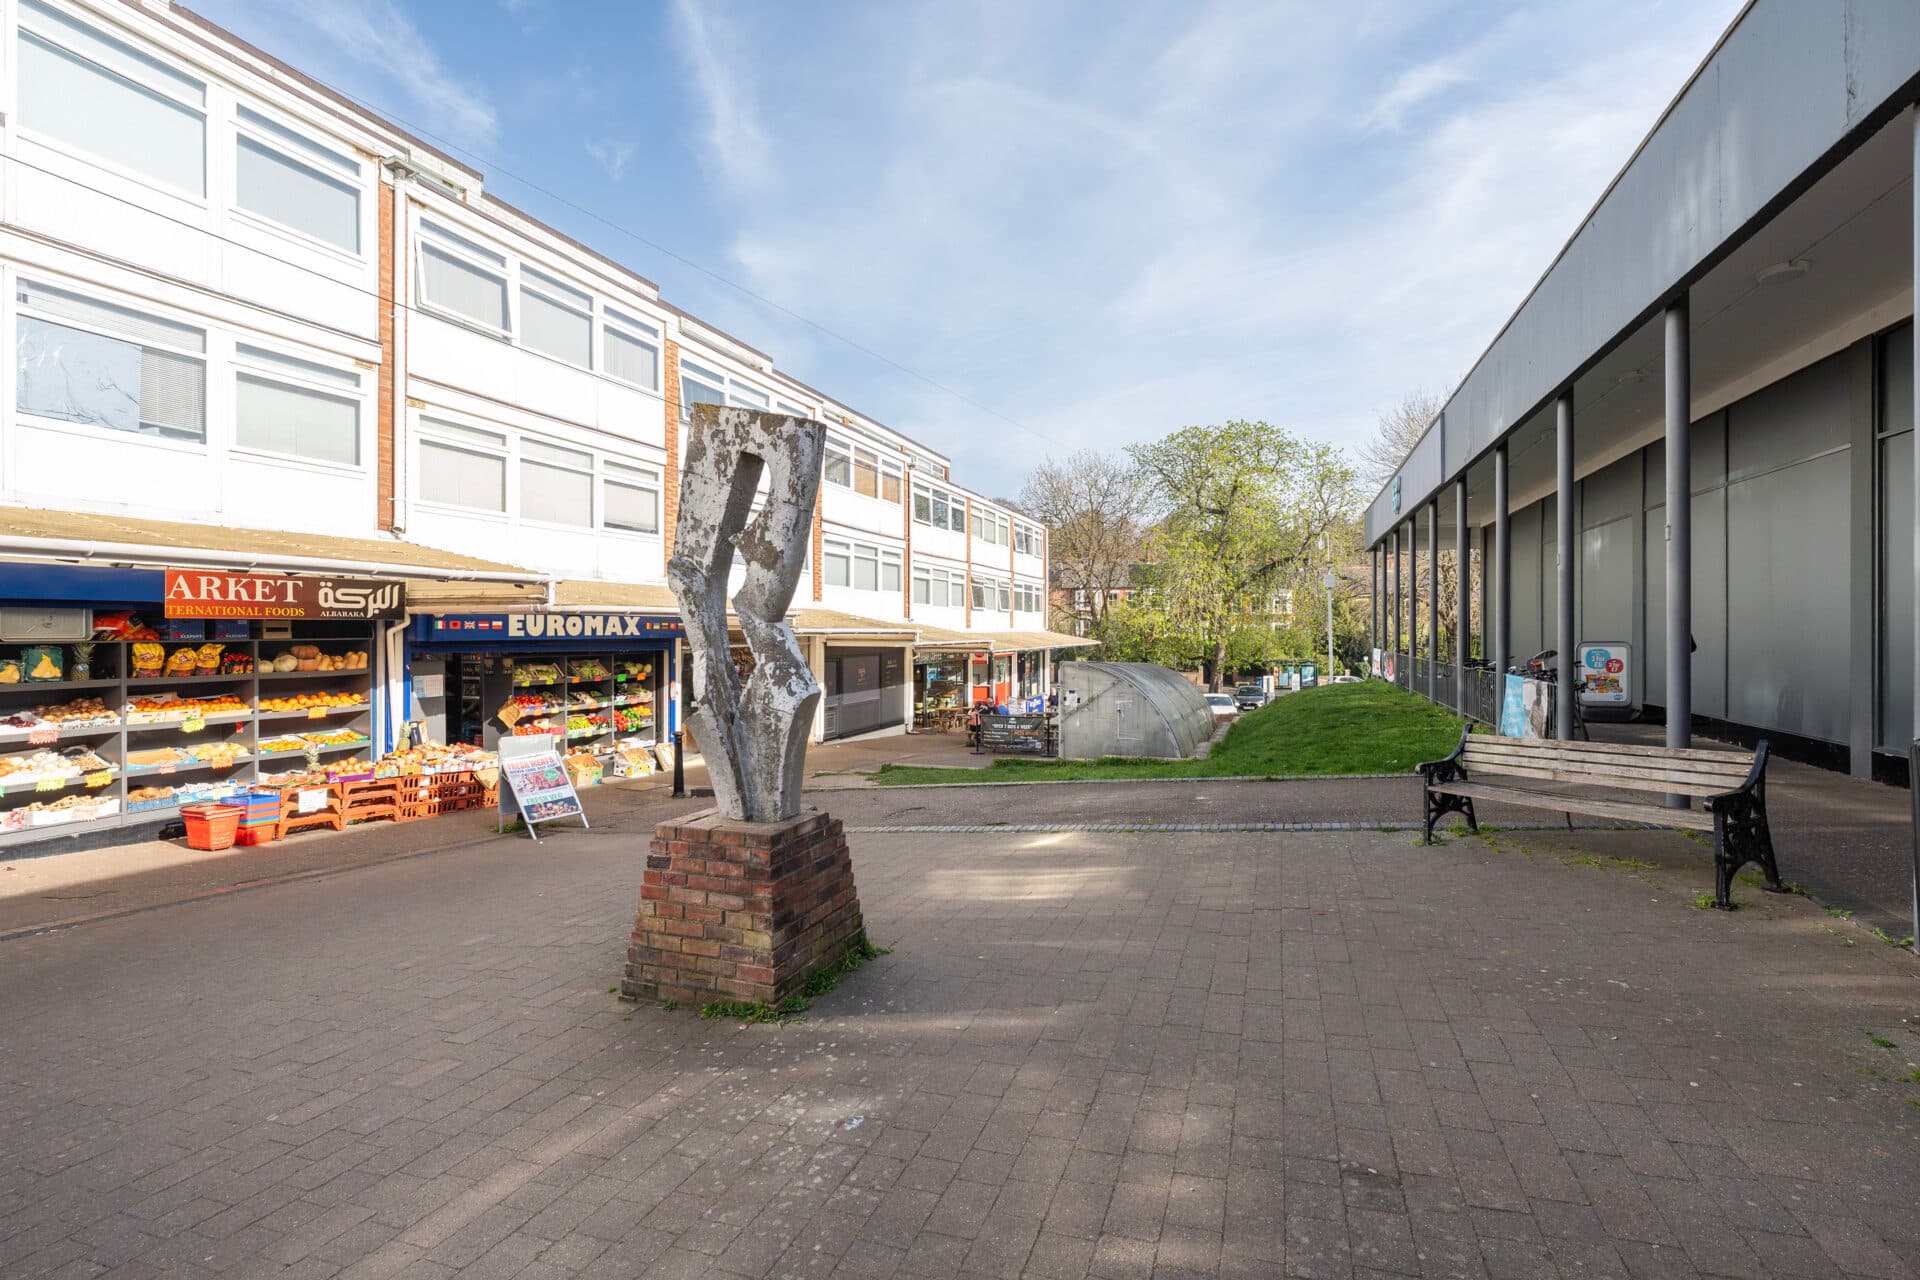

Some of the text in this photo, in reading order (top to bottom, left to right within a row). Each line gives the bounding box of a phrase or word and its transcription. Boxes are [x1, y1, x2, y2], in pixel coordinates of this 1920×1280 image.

[167, 574, 303, 603] ARKET
[318, 581, 400, 618] البركة
[166, 605, 305, 617] TERNATIONAL FOODS
[508, 614, 641, 637] EUROMAX
